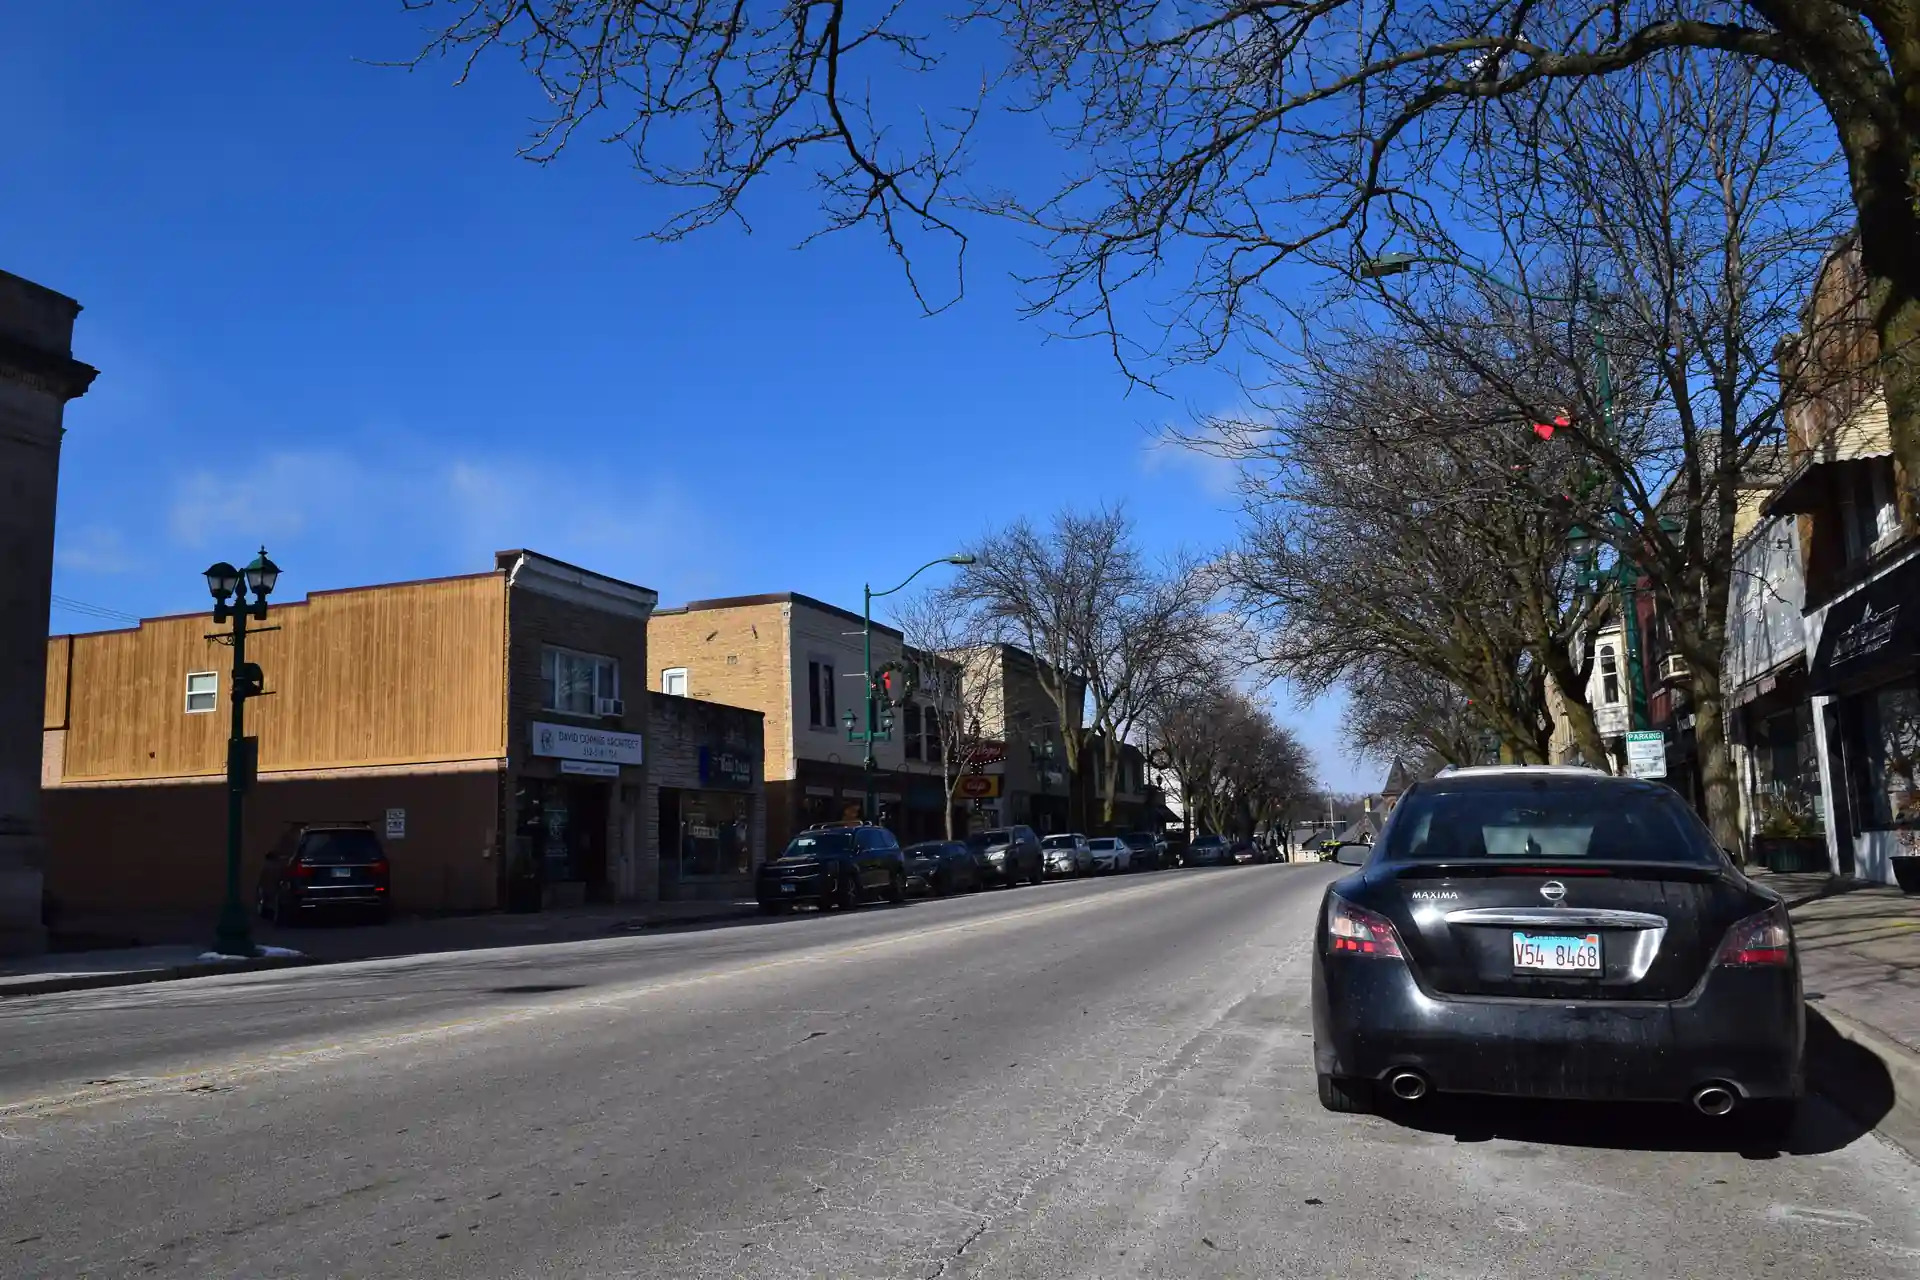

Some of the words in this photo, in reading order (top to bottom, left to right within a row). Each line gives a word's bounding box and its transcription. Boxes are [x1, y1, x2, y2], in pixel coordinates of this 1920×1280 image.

[558, 731, 579, 743] DAVID
[1628, 732, 1661, 741] PARKING
[1412, 891, 1458, 900] MAXIMA
[1516, 944, 1544, 965] V54
[1556, 945, 1597, 967] 8468
